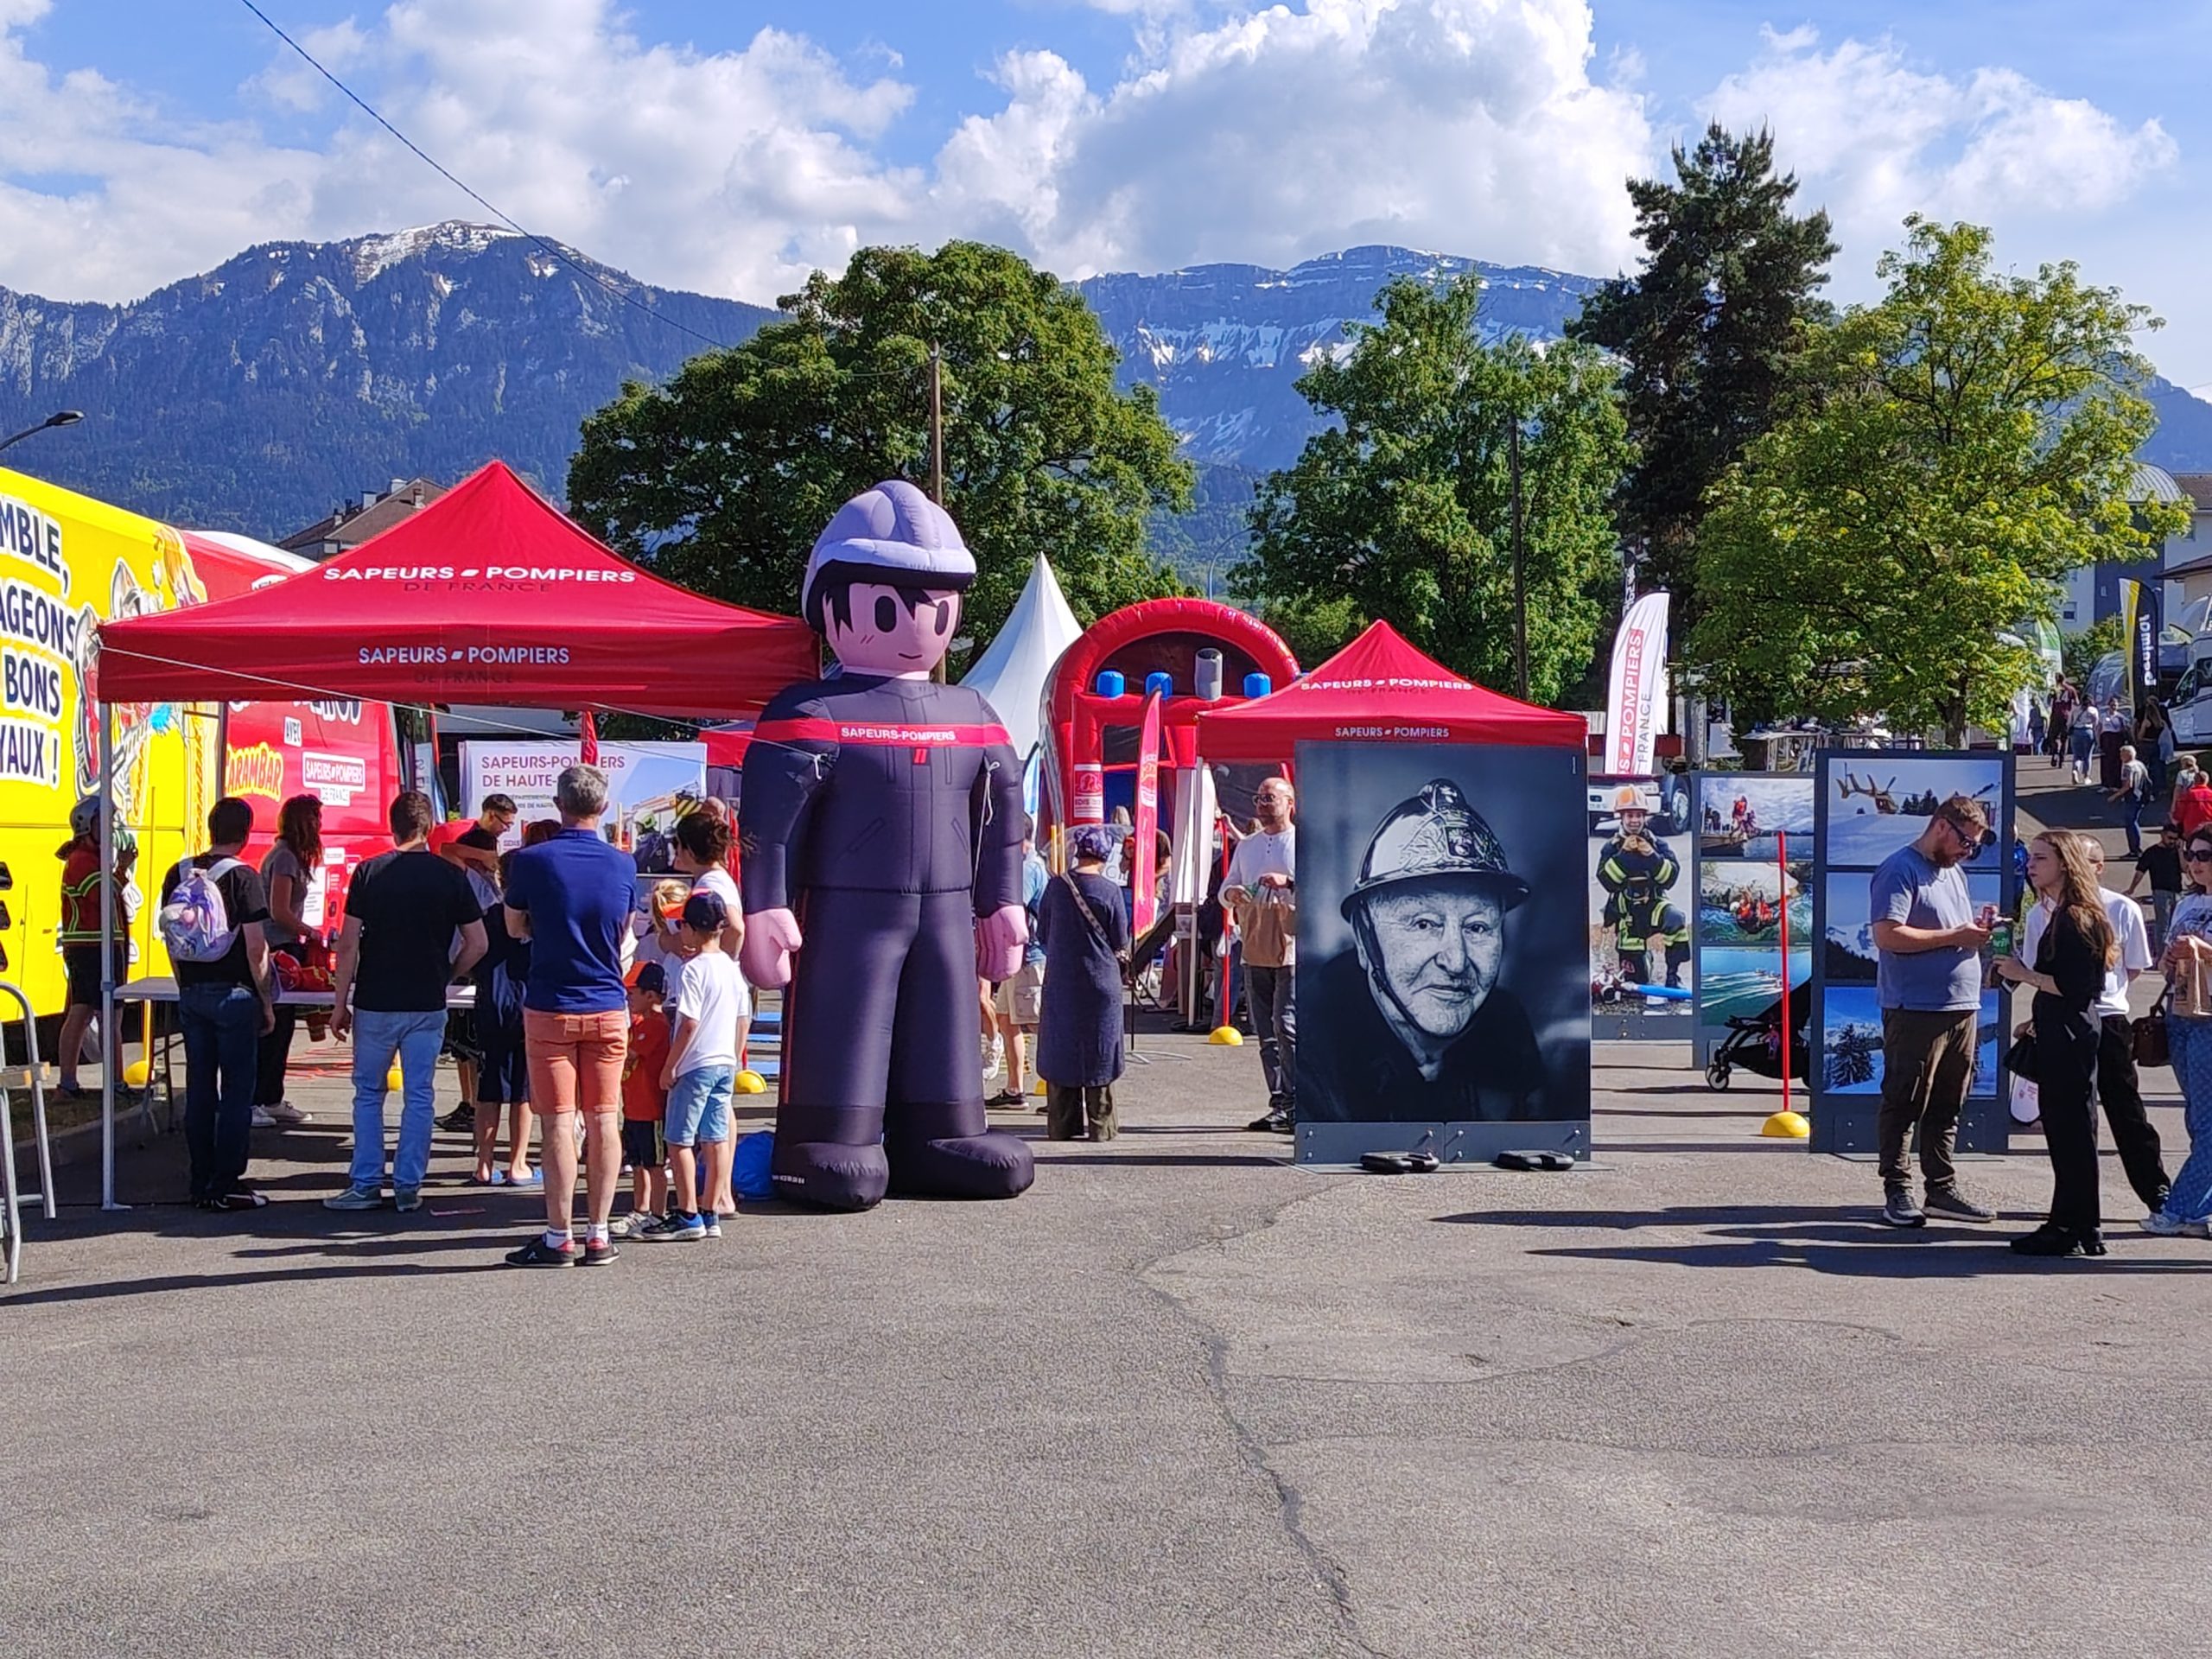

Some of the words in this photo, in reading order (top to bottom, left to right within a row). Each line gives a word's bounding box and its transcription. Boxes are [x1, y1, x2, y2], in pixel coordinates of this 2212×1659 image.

[323, 567, 454, 580] SAPEURS
[486, 566, 636, 582] POMPIERS
[448, 582, 551, 592] FRANCE
[359, 647, 448, 664] SAPEURS
[467, 646, 570, 664] POMPIERS
[4, 654, 60, 717] BONS
[1300, 678, 1372, 690] SAPEURS
[1389, 677, 1473, 690] POMPIERS
[1622, 634, 1643, 738] POMPIERS
[841, 727, 957, 741] SAPEURS-POMPIERS
[1335, 727, 1383, 738] SAPEURS
[1394, 727, 1450, 738] POMPIERS
[1637, 692, 1652, 763] FRANCE
[481, 756, 626, 769] SAPEURS-POERS
[483, 775, 501, 787] DE
